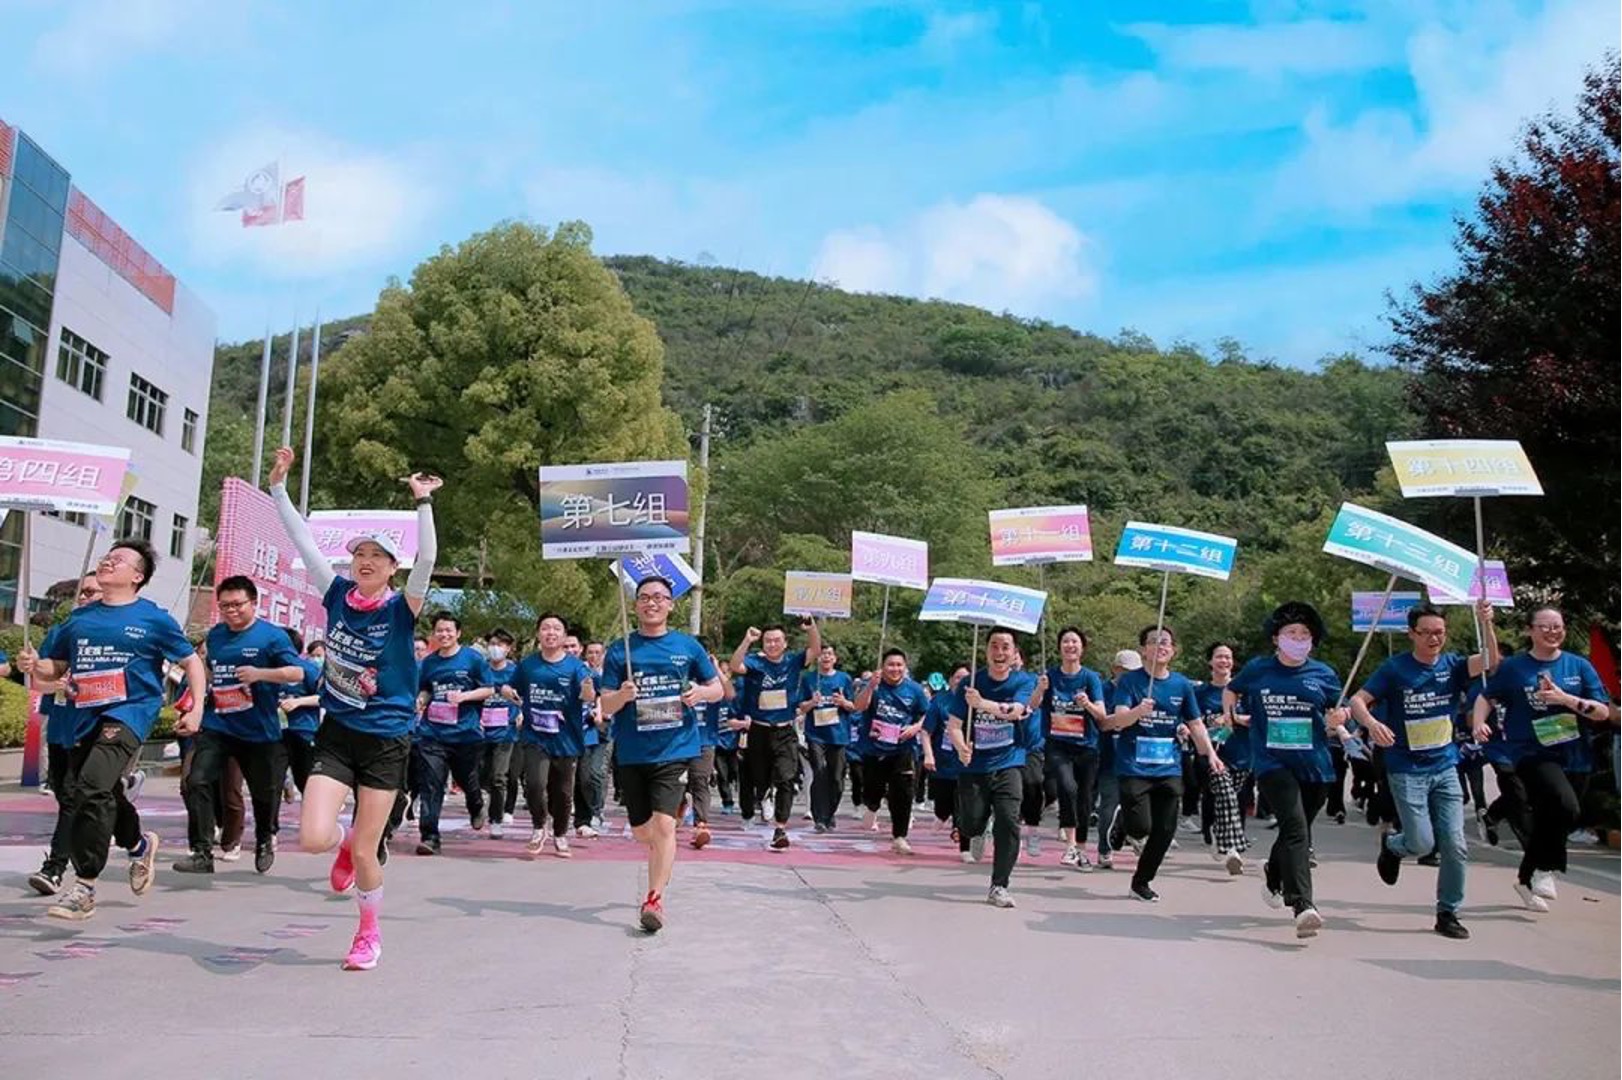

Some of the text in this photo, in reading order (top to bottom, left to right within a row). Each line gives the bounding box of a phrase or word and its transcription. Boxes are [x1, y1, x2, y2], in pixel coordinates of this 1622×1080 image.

[1408, 456, 1518, 477] 第十四组
[560, 491, 669, 529] 第七组
[1002, 524, 1080, 546] 第十一组
[1131, 533, 1223, 563] 第十二组
[1344, 521, 1460, 577] 第十三组
[942, 589, 1026, 614] 第十组
